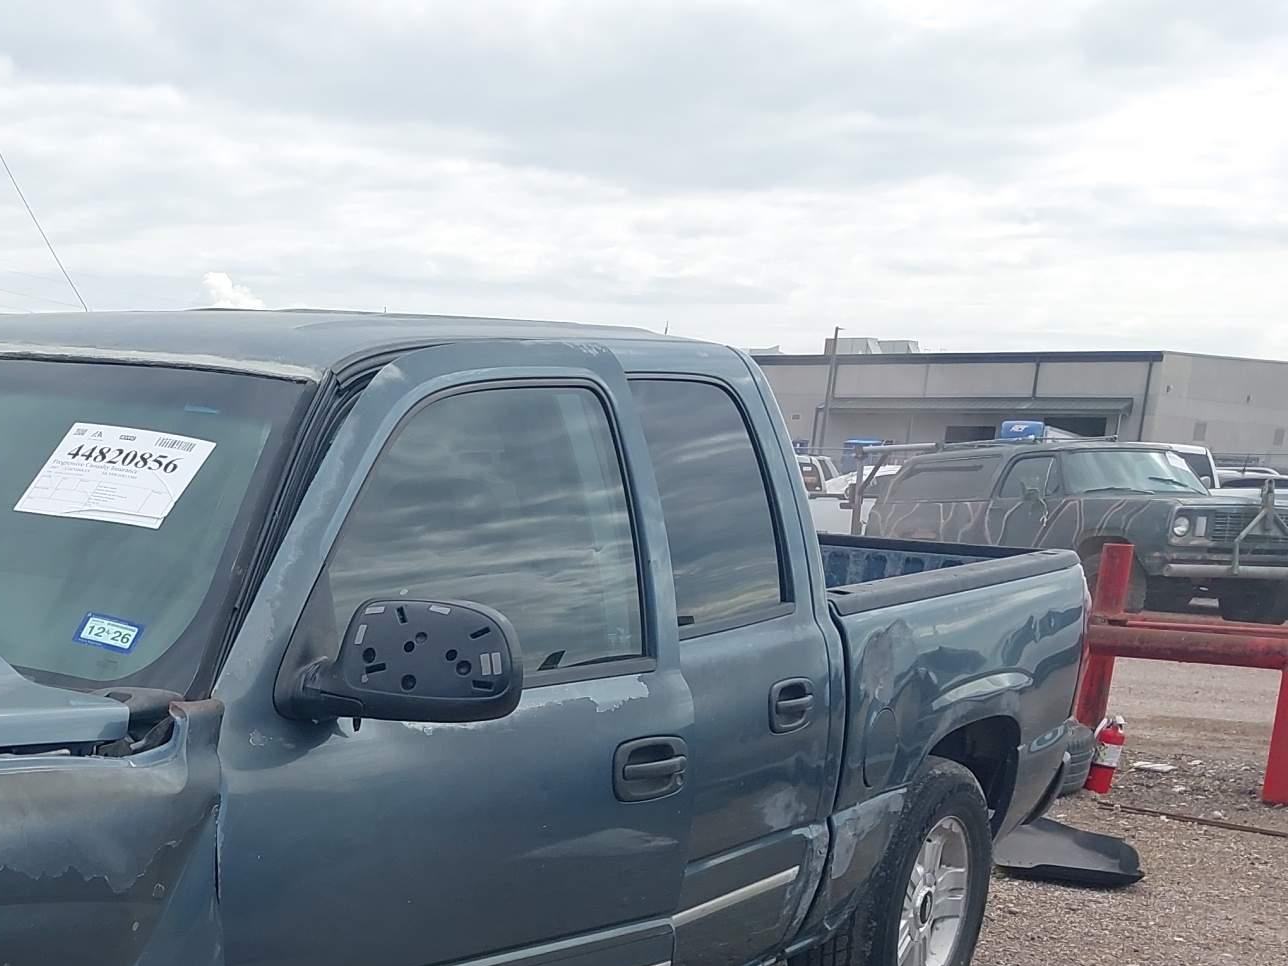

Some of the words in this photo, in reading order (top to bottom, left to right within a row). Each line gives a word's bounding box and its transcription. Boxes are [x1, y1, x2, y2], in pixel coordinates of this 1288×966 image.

[67, 443, 185, 475] 44820856
[87, 625, 106, 638] 12
[110, 630, 132, 644] 26
